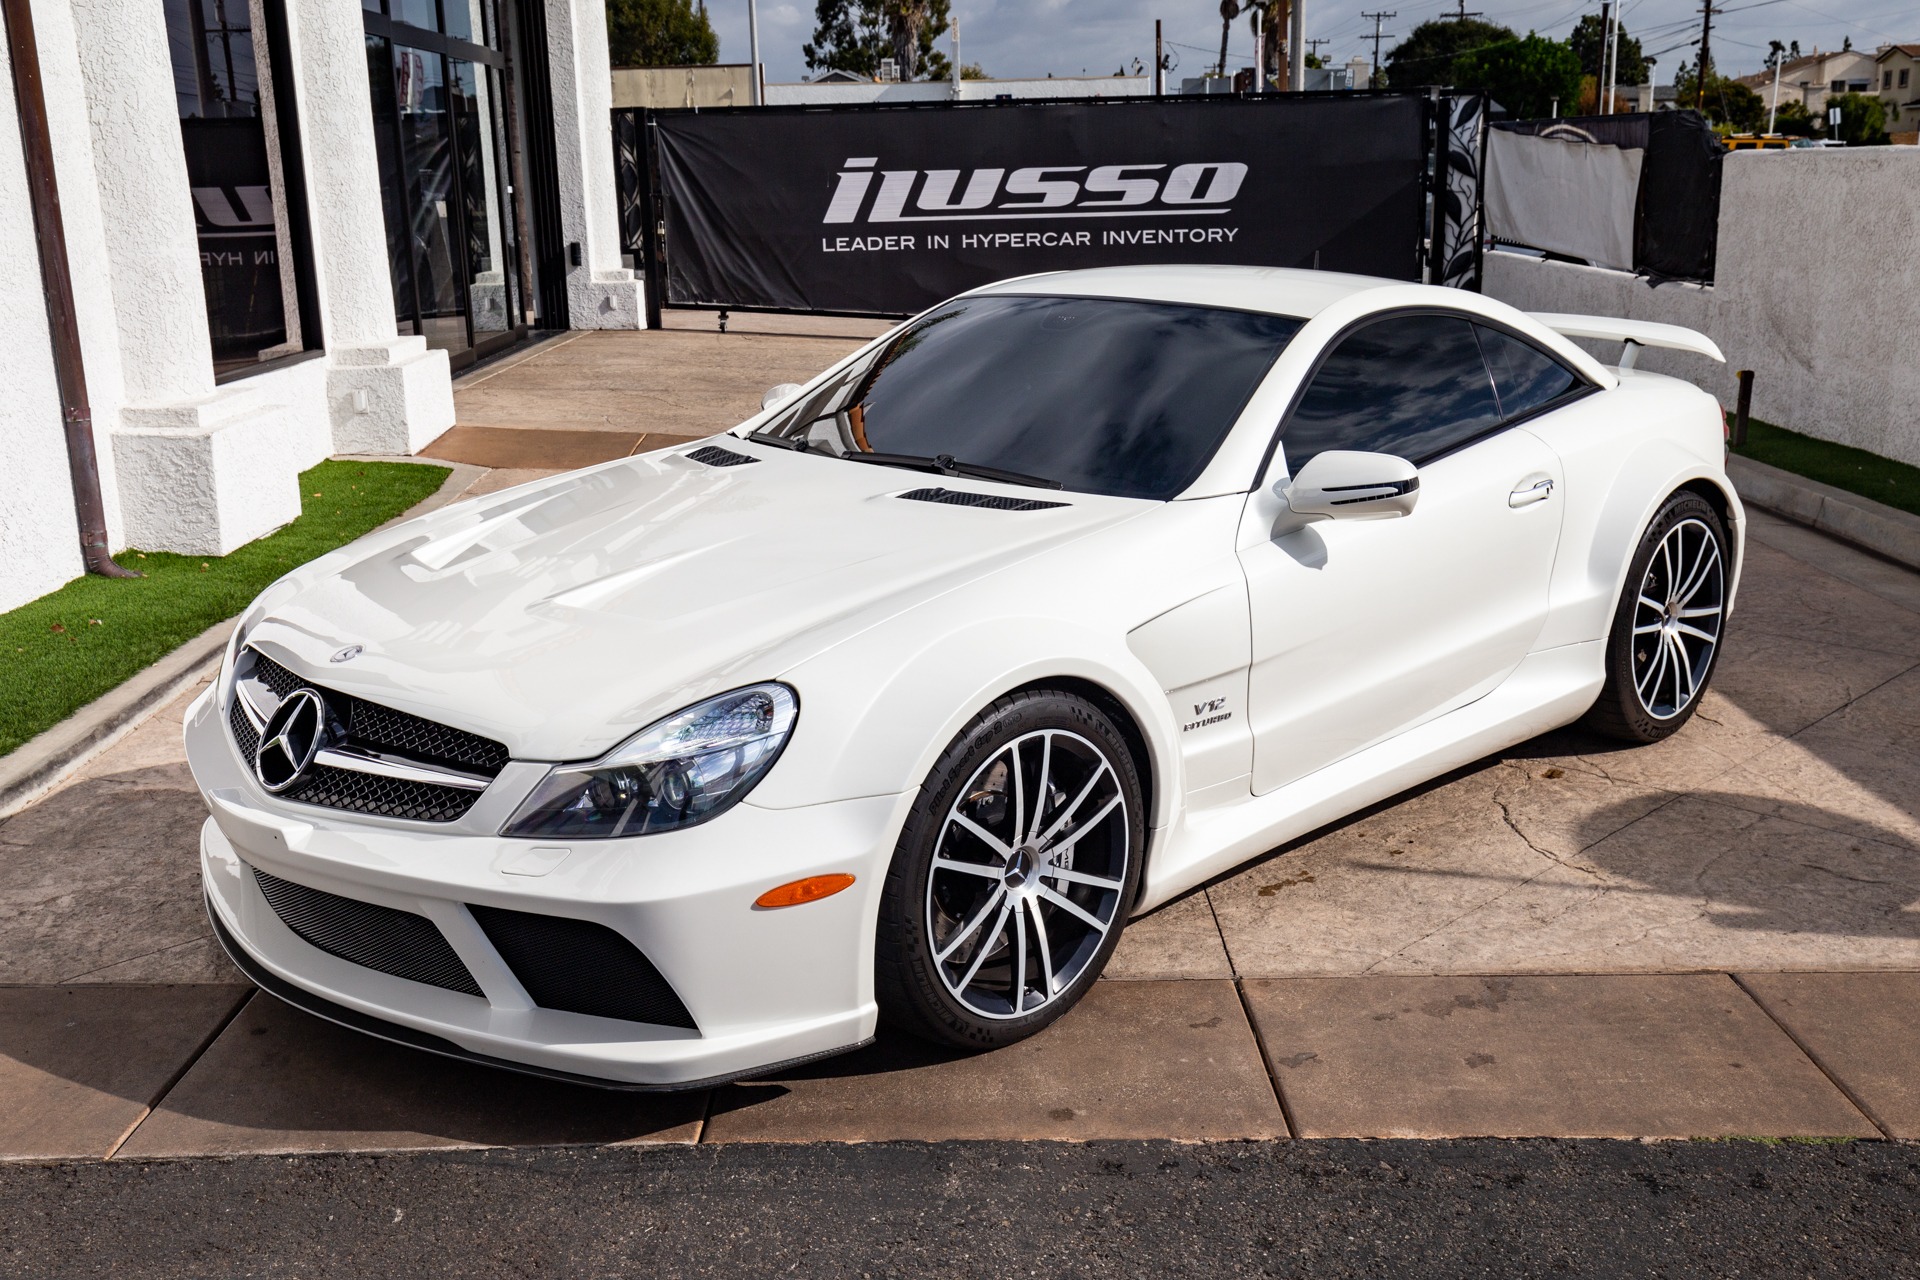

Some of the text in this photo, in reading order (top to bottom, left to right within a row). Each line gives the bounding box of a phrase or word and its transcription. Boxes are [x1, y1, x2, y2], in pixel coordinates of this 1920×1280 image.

[823, 228, 1239, 252] LEADER IN HYPERCAR INVENTORY
[1194, 697, 1226, 716] V12
[974, 731, 994, 750] Cup
